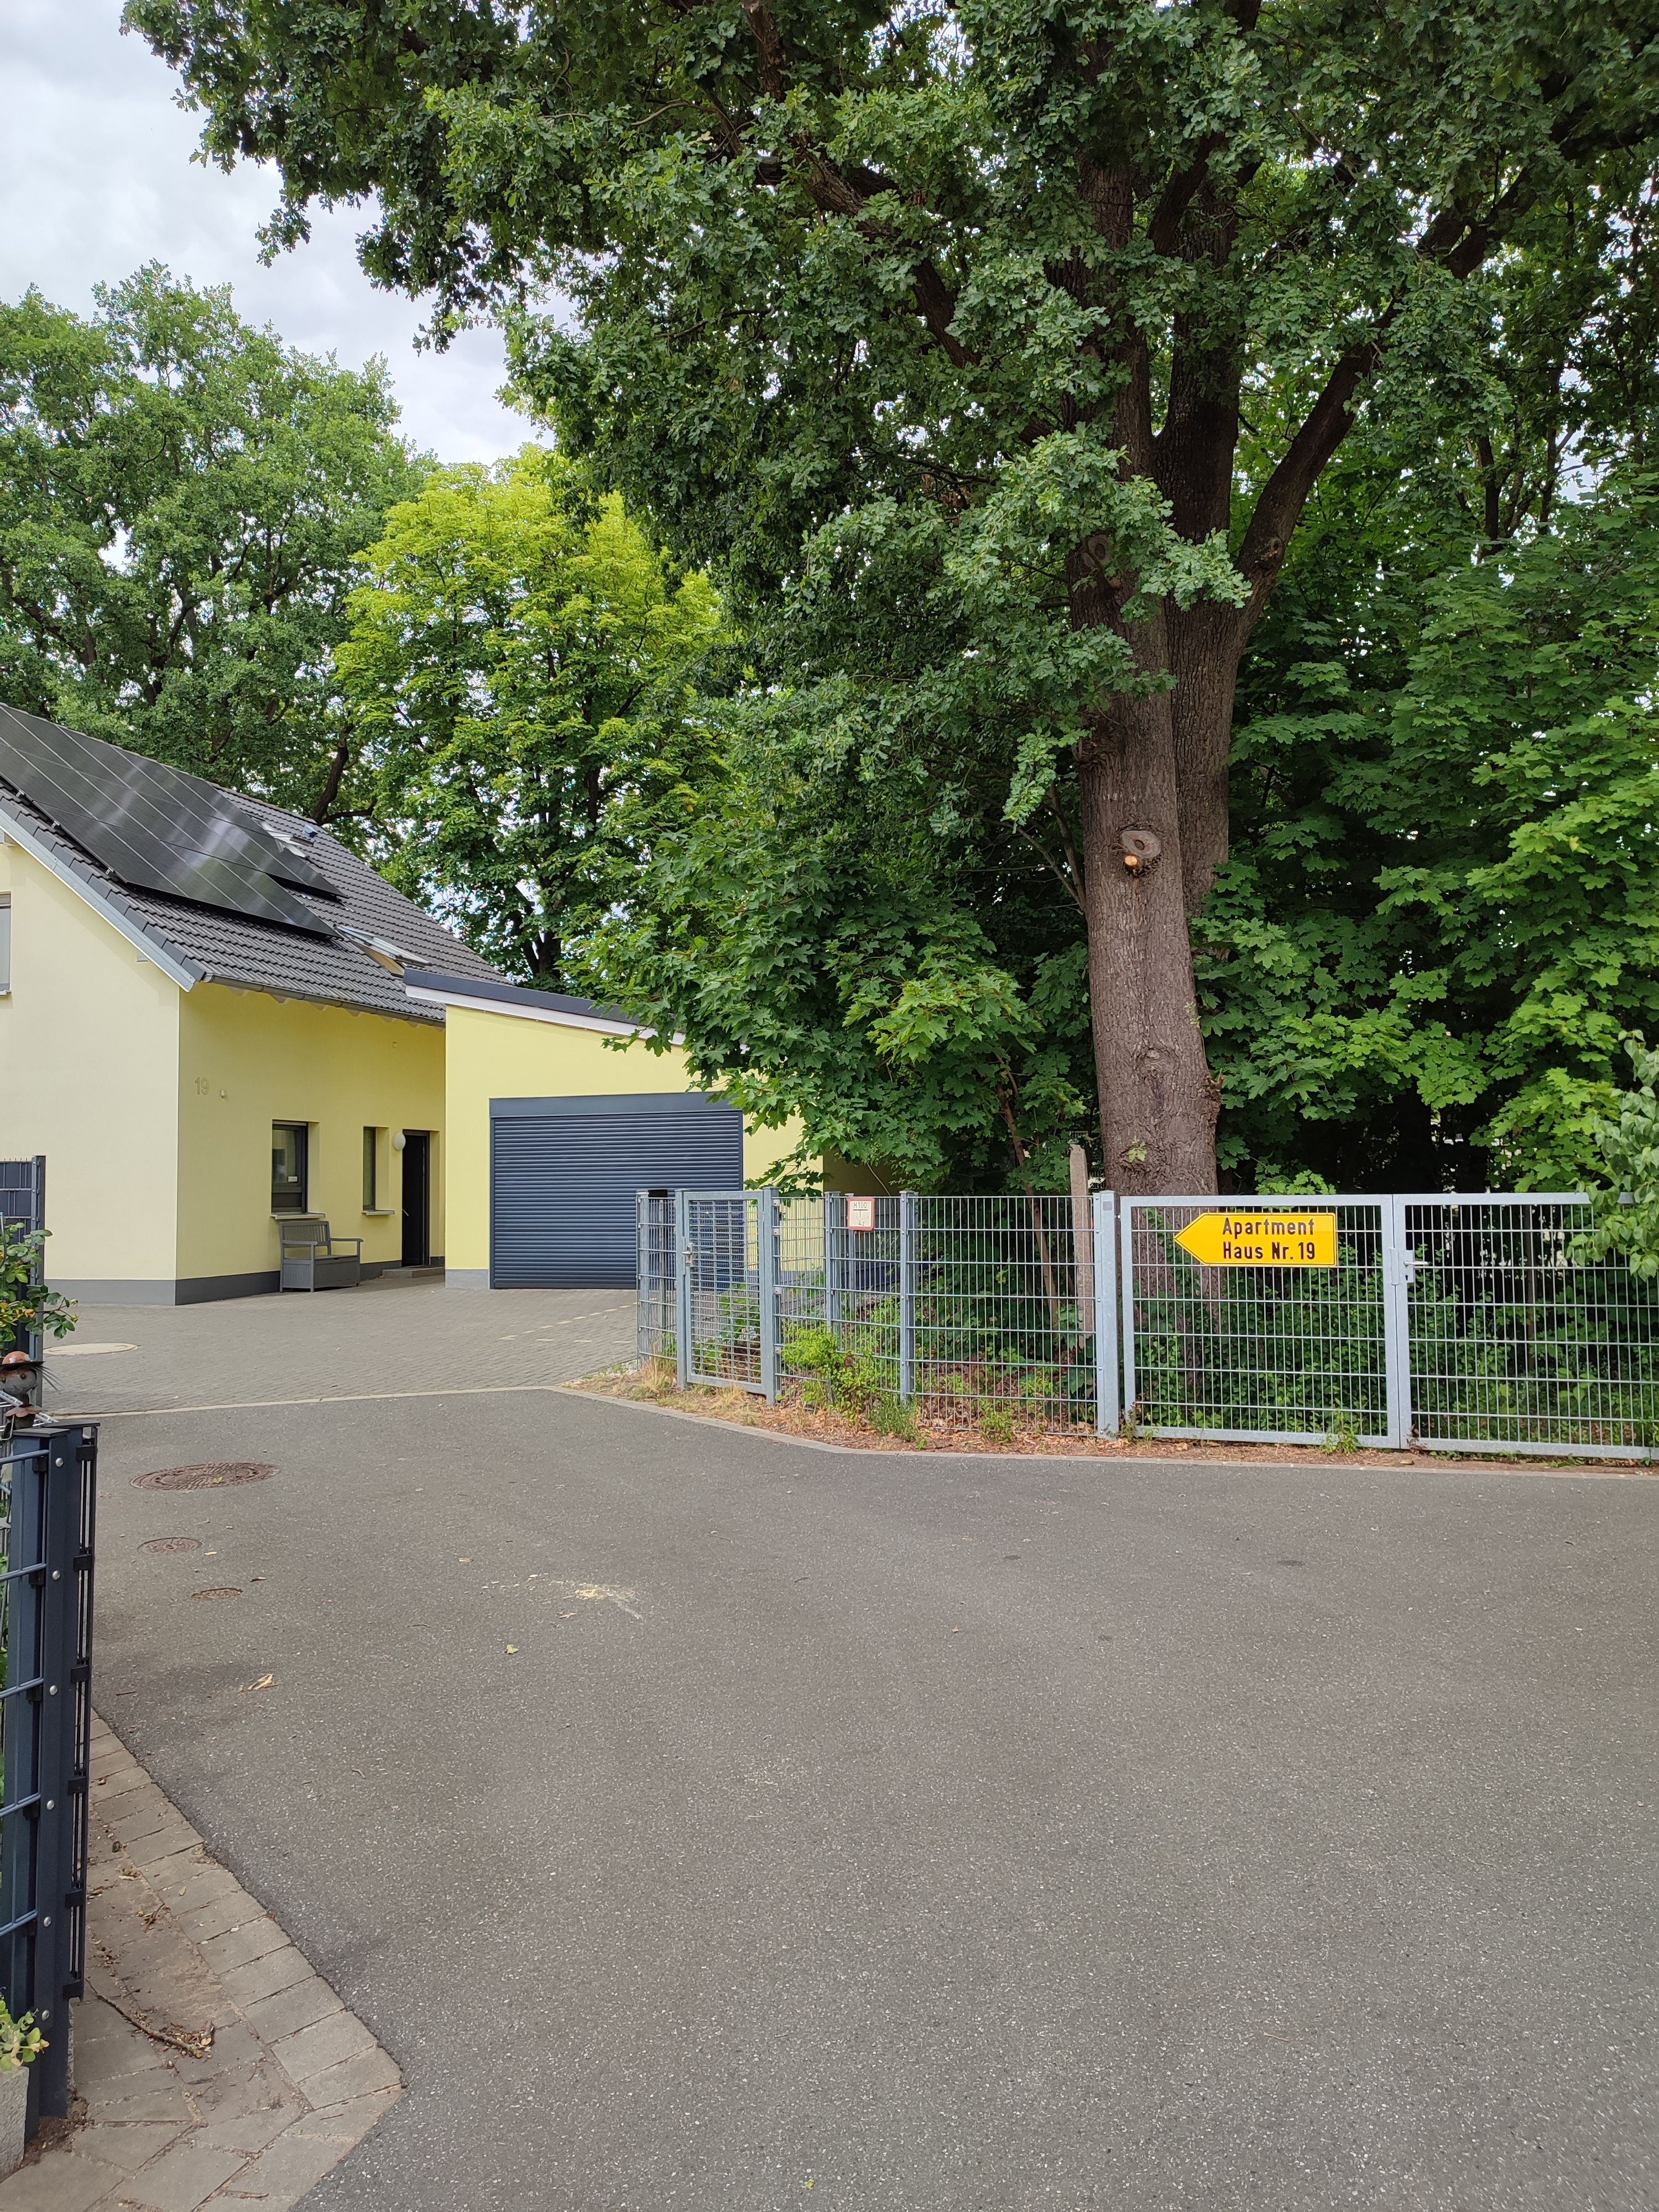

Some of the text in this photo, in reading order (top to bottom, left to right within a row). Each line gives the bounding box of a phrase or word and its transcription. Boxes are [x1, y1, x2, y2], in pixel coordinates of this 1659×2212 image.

[195, 1077, 209, 1095] 19
[1223, 1217, 1314, 1239] Apartment
[1223, 1241, 1315, 1260] Haus Nr. 19
